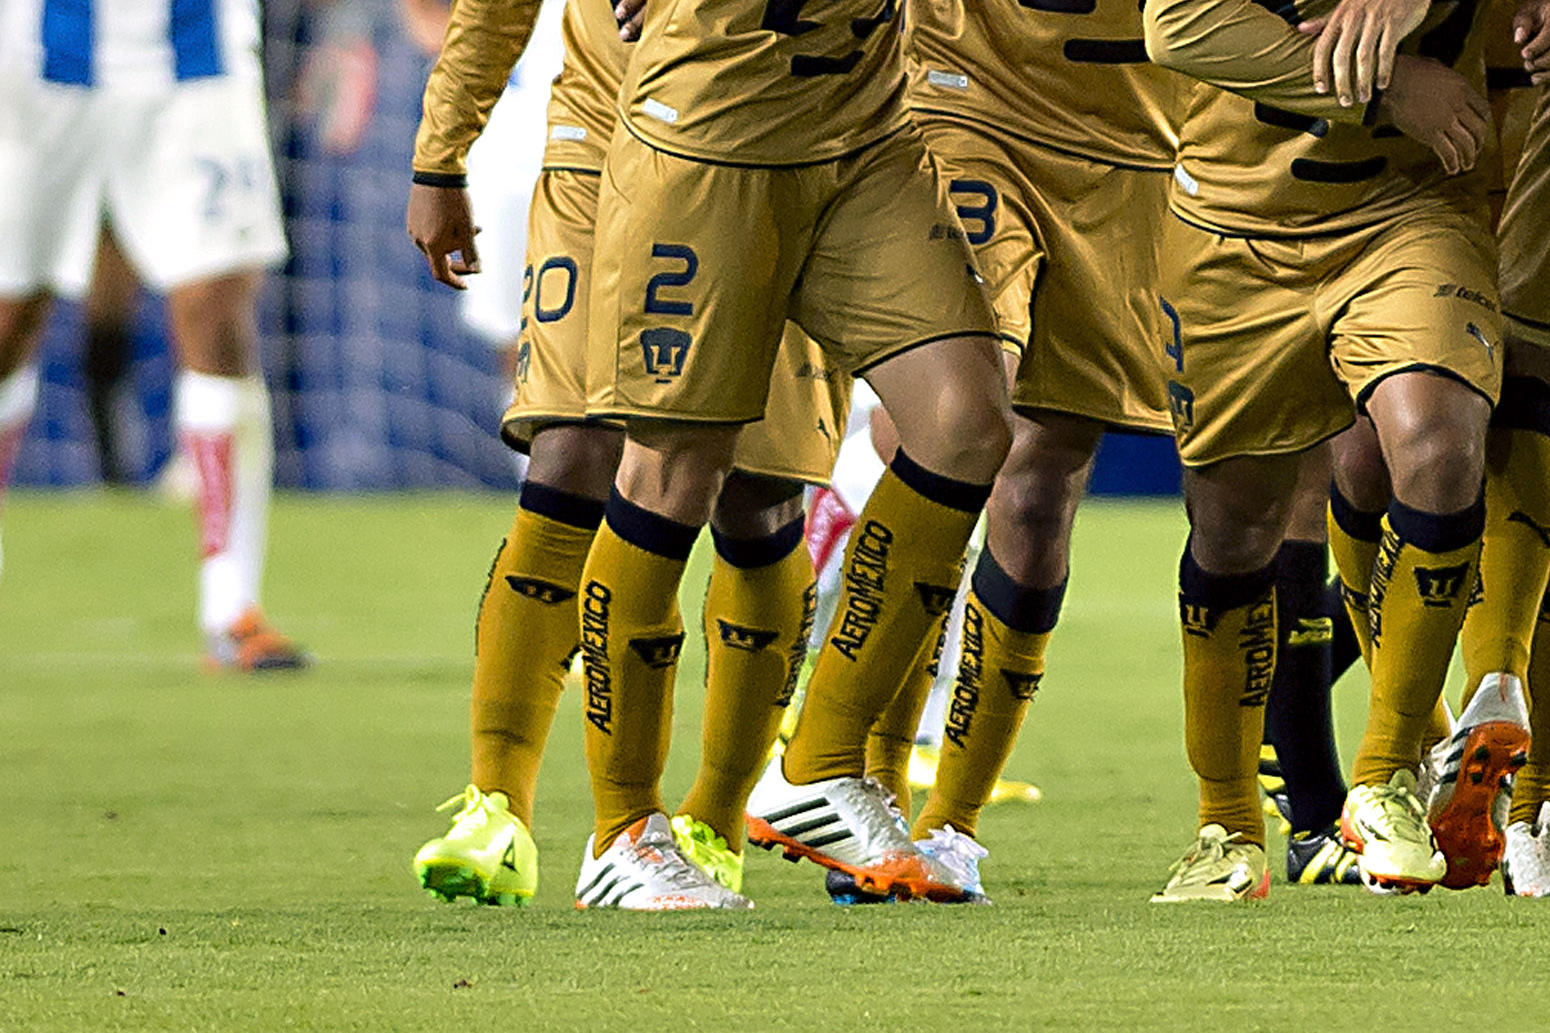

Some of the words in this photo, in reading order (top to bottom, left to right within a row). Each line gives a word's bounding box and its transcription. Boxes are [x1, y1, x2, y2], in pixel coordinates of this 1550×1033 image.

[645, 243, 700, 316] 2
[584, 580, 612, 736] AEROMEXICO
[831, 520, 893, 662] AEROMEXICO
[945, 603, 984, 749] AEROMEXICO
